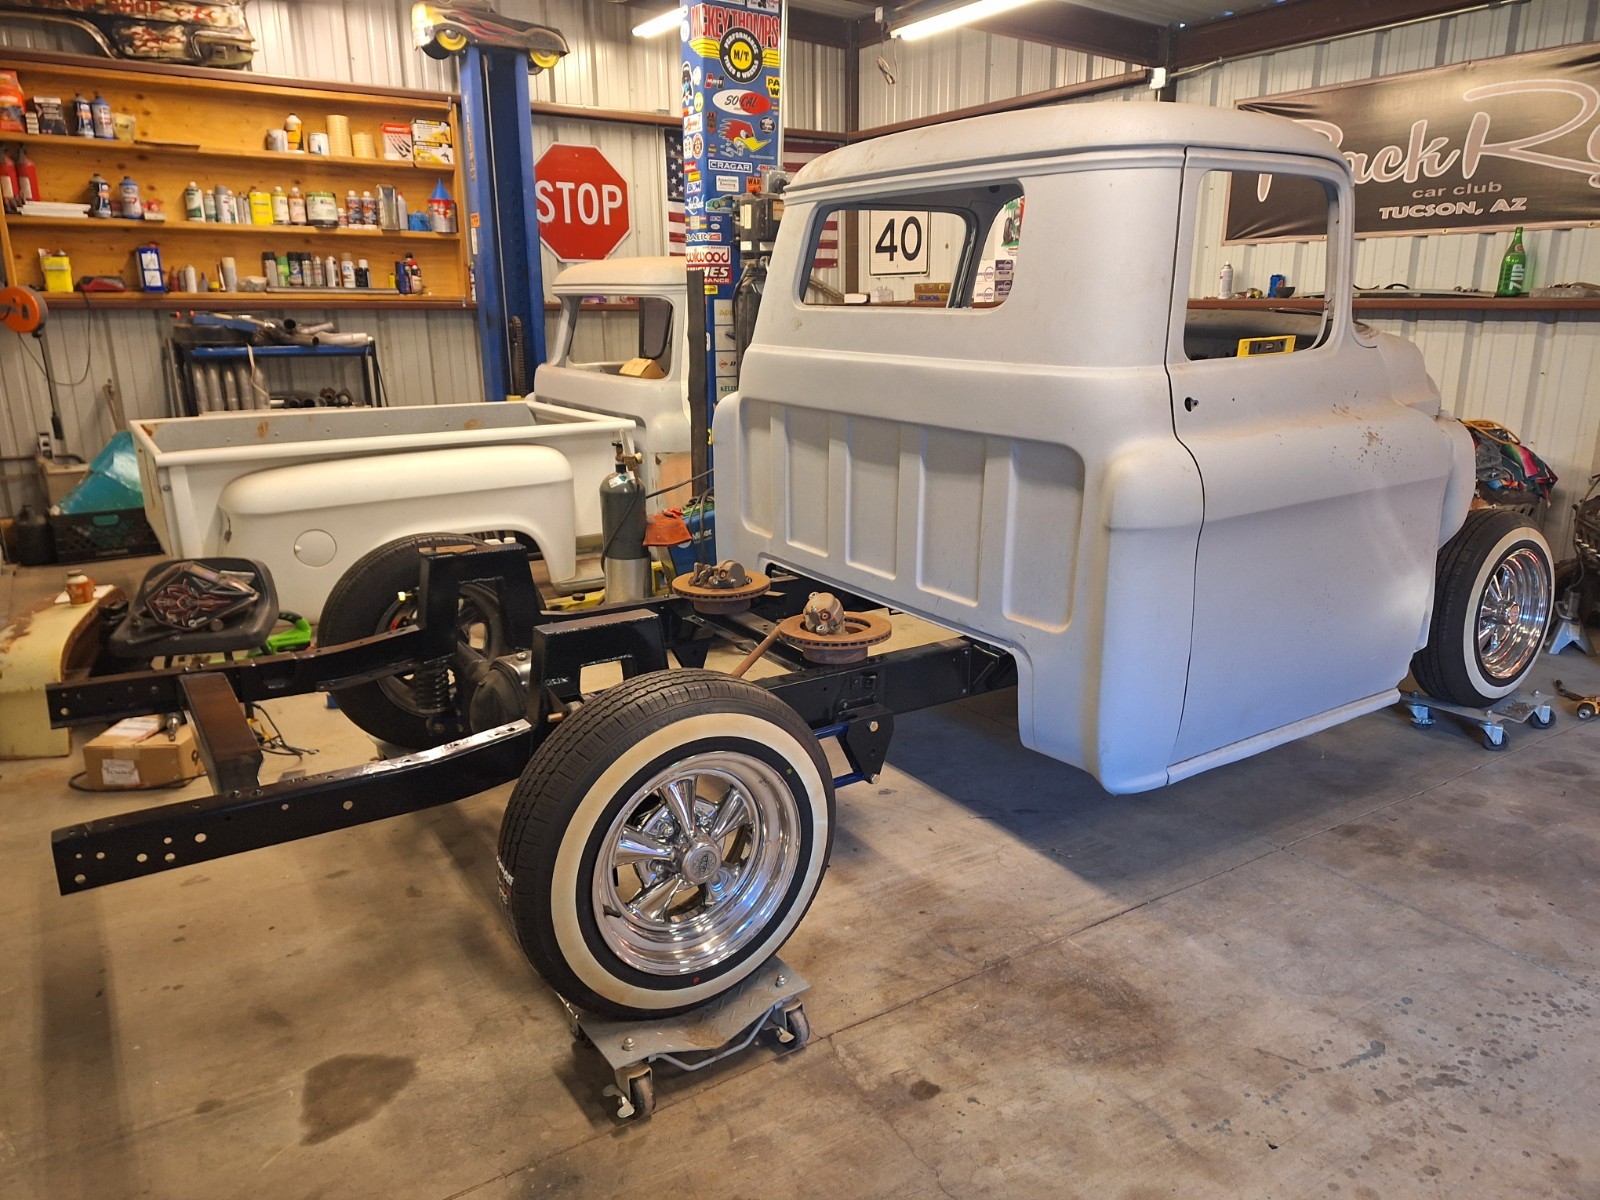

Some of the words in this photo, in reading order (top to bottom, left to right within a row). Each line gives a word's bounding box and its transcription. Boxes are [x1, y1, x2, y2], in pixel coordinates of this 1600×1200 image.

[723, 31, 759, 55] PERFORMANCE
[733, 49, 750, 62] M/T
[741, 59, 759, 79] WHEELS
[710, 162, 751, 172] CRAGAR
[1411, 187, 1447, 199] car
[1452, 181, 1502, 196] club
[534, 180, 623, 226] STOP
[1378, 200, 1484, 220] TUCSON,
[1489, 197, 1528, 213] AZ
[875, 216, 922, 262] 40
